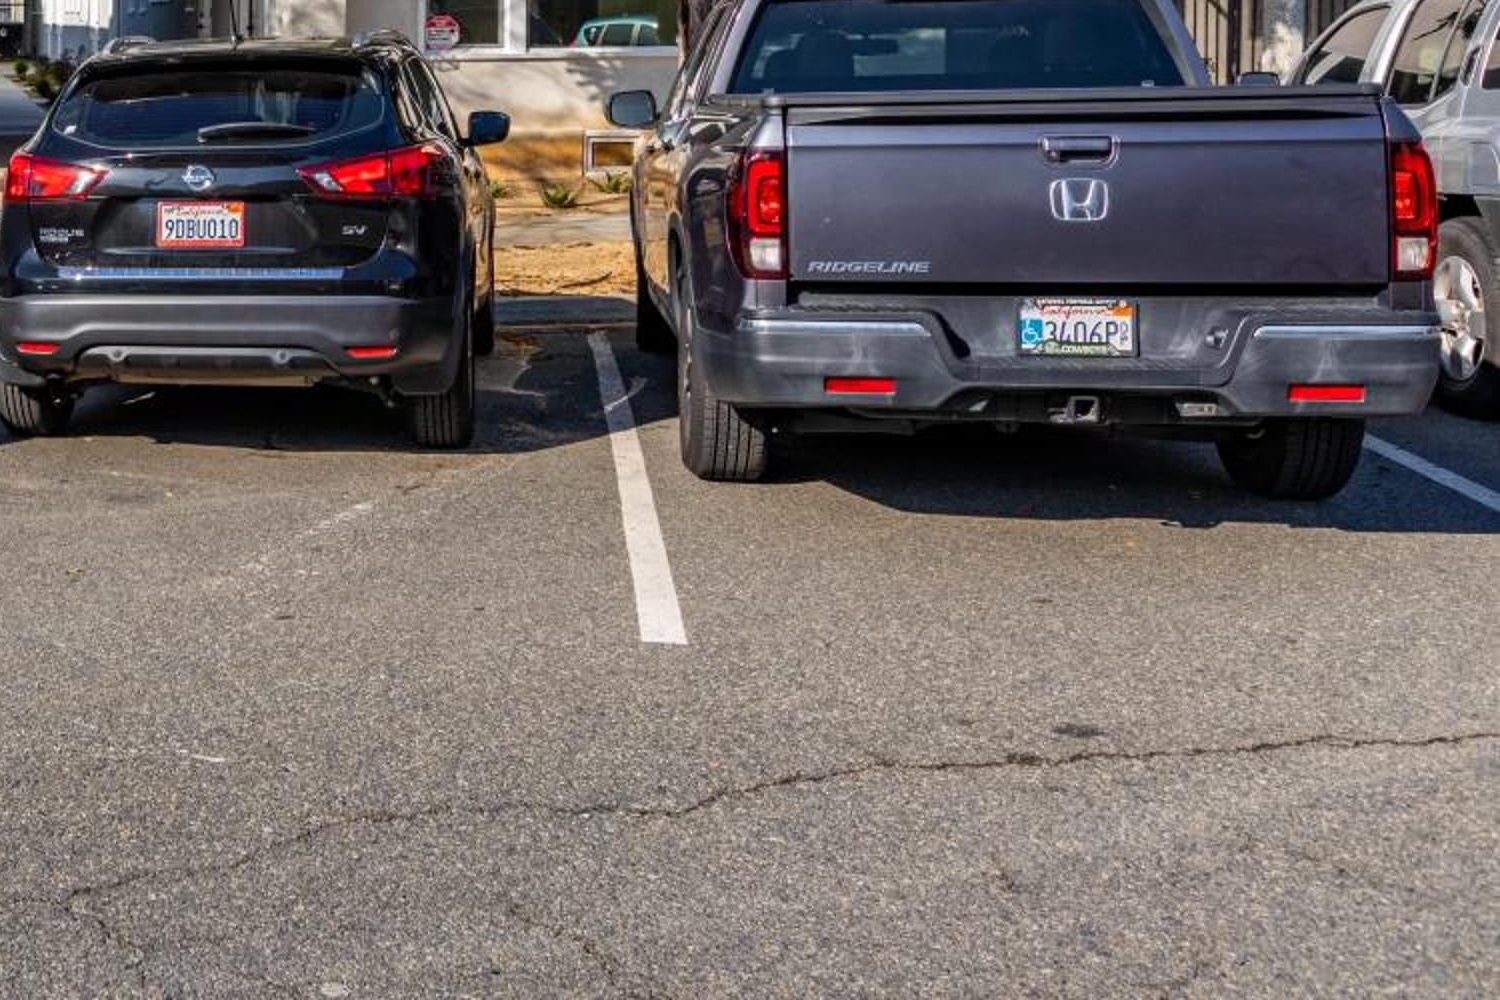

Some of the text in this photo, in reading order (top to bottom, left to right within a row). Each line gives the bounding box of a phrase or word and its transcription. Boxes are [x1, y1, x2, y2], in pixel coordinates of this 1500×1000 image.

[165, 218, 239, 239] 9DBU010
[342, 225, 367, 235] SV
[807, 261, 931, 273] RIDGELINE
